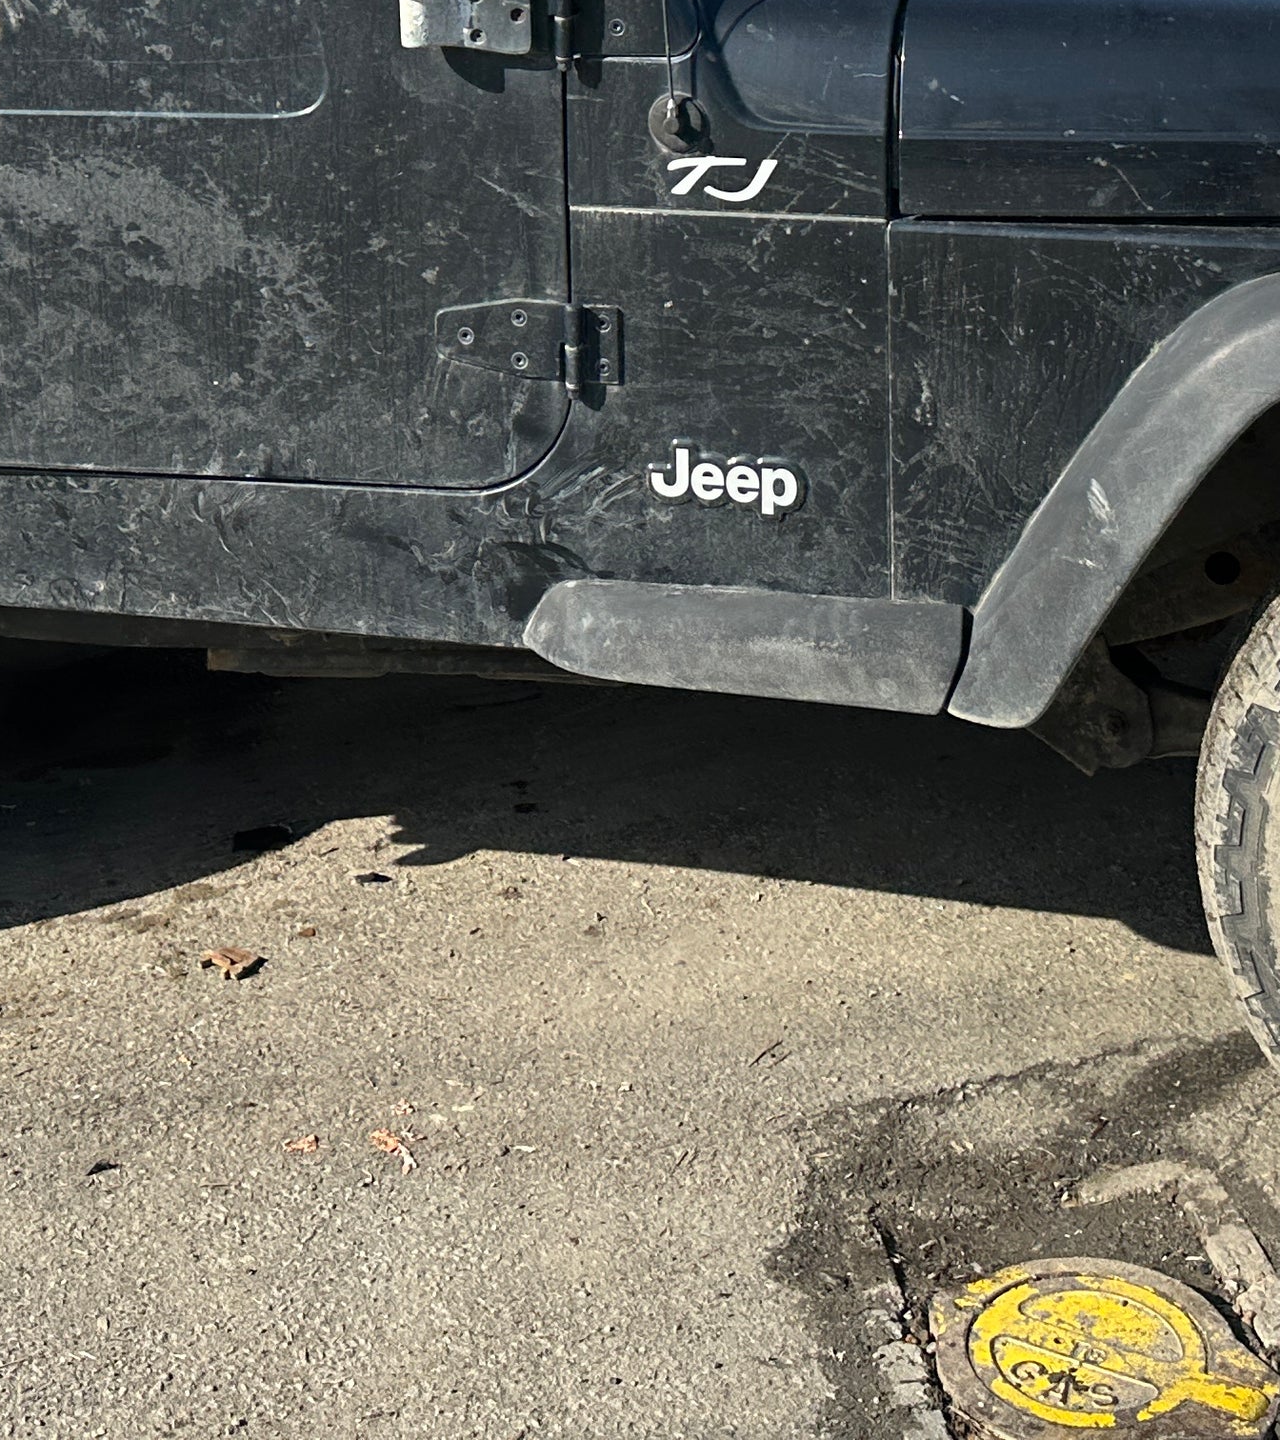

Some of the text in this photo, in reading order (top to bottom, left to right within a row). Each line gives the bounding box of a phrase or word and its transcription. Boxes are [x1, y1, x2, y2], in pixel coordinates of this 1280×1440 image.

[667, 156, 779, 202] TJ
[649, 444, 801, 517] Jeep
[1010, 1360, 1120, 1407] GAS
